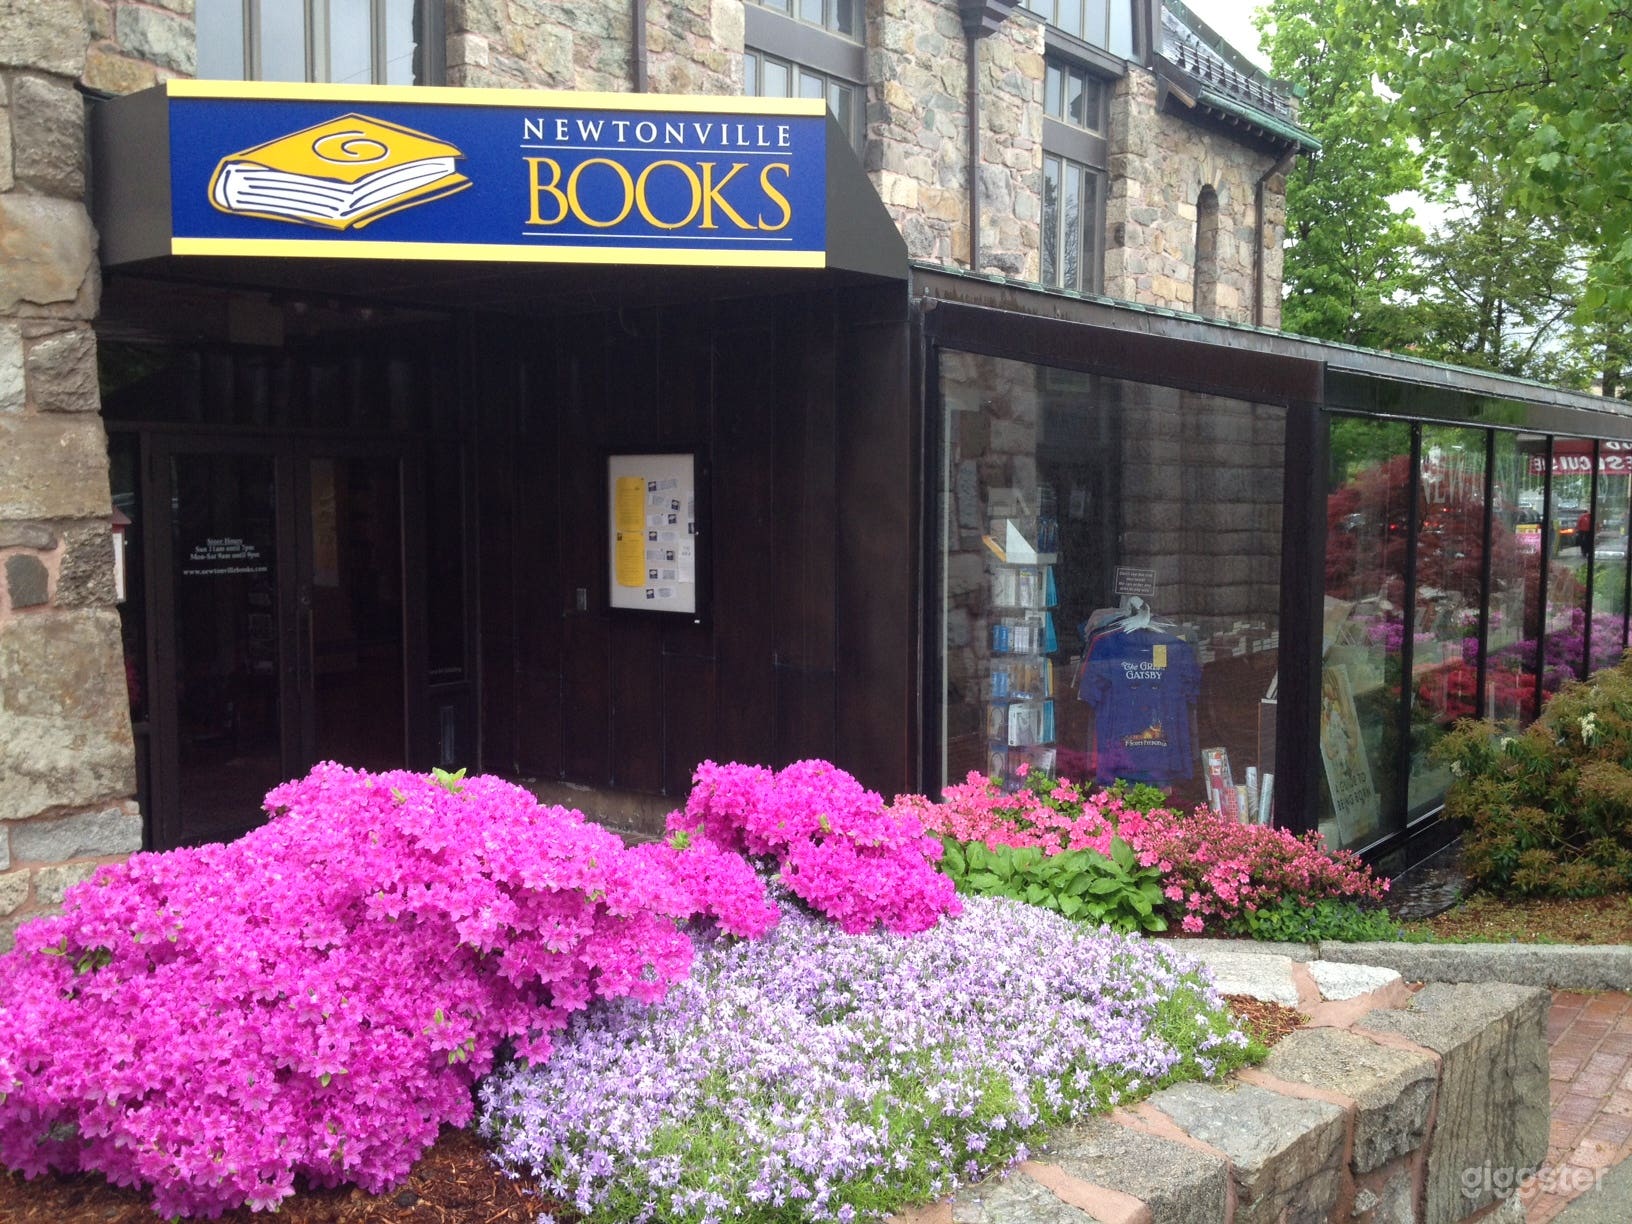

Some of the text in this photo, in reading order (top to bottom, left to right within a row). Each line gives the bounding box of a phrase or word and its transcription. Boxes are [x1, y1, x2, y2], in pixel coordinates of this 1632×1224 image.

[523, 117, 791, 147] NEWTONVILLE
[522, 156, 792, 231] BOOKS
[1121, 662, 1138, 670] The
[1126, 670, 1162, 679] GATSBY
